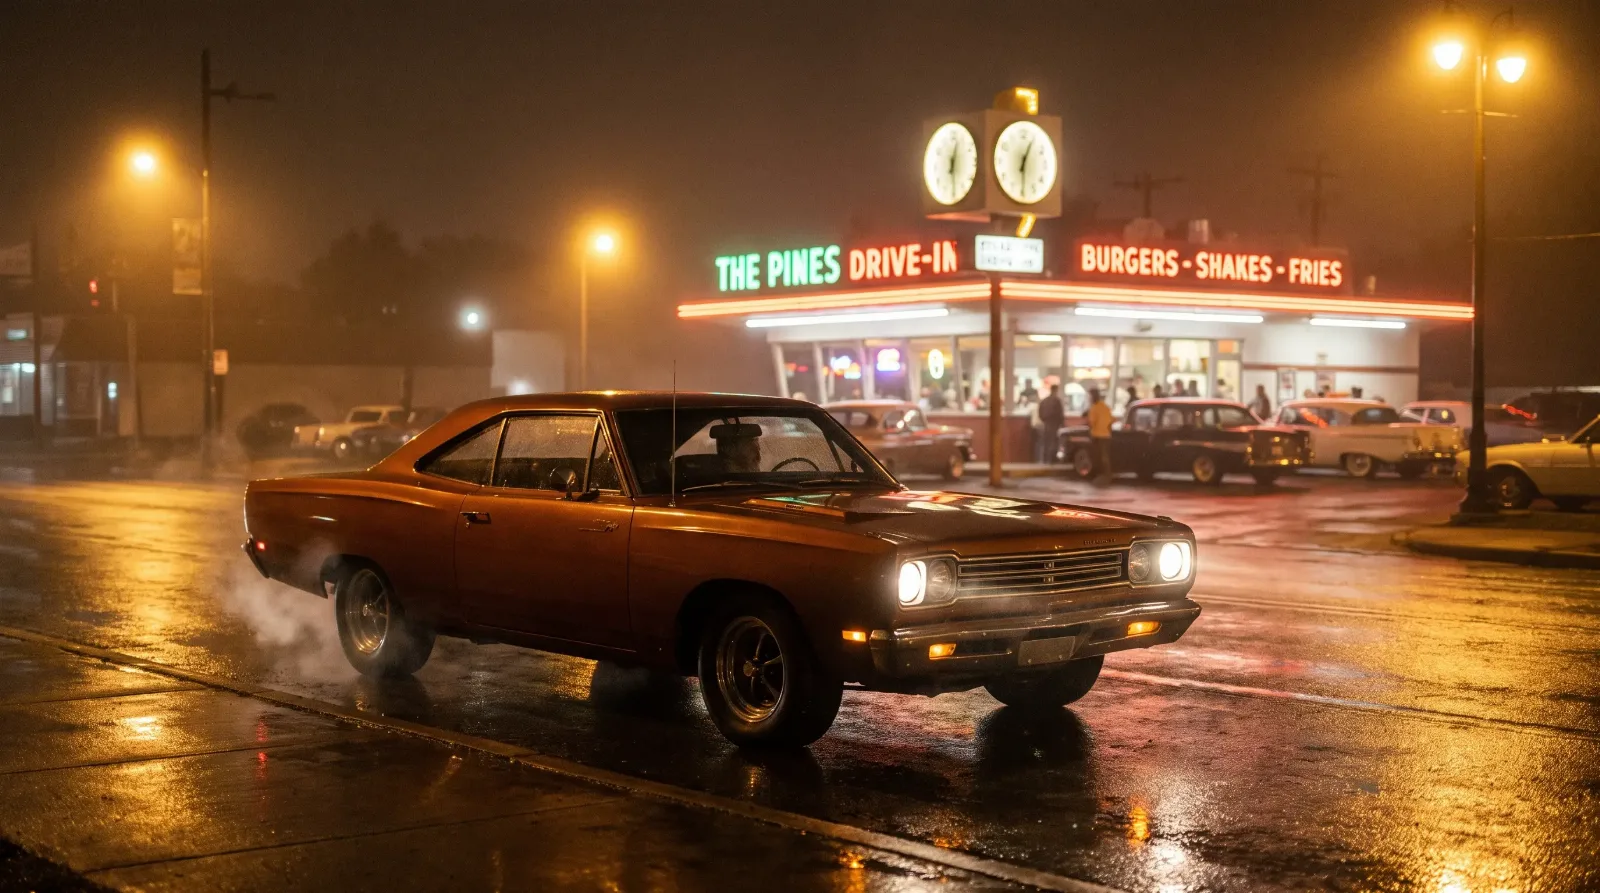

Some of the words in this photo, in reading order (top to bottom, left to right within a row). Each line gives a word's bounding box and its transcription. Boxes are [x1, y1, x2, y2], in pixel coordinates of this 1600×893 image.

[716, 254, 760, 292] THE
[767, 245, 841, 287] PINES
[849, 240, 958, 280] DRIVE-IN
[1081, 243, 1179, 277] BURGERS
[1195, 251, 1273, 283] SHAKES
[1289, 258, 1342, 287] FRIES
